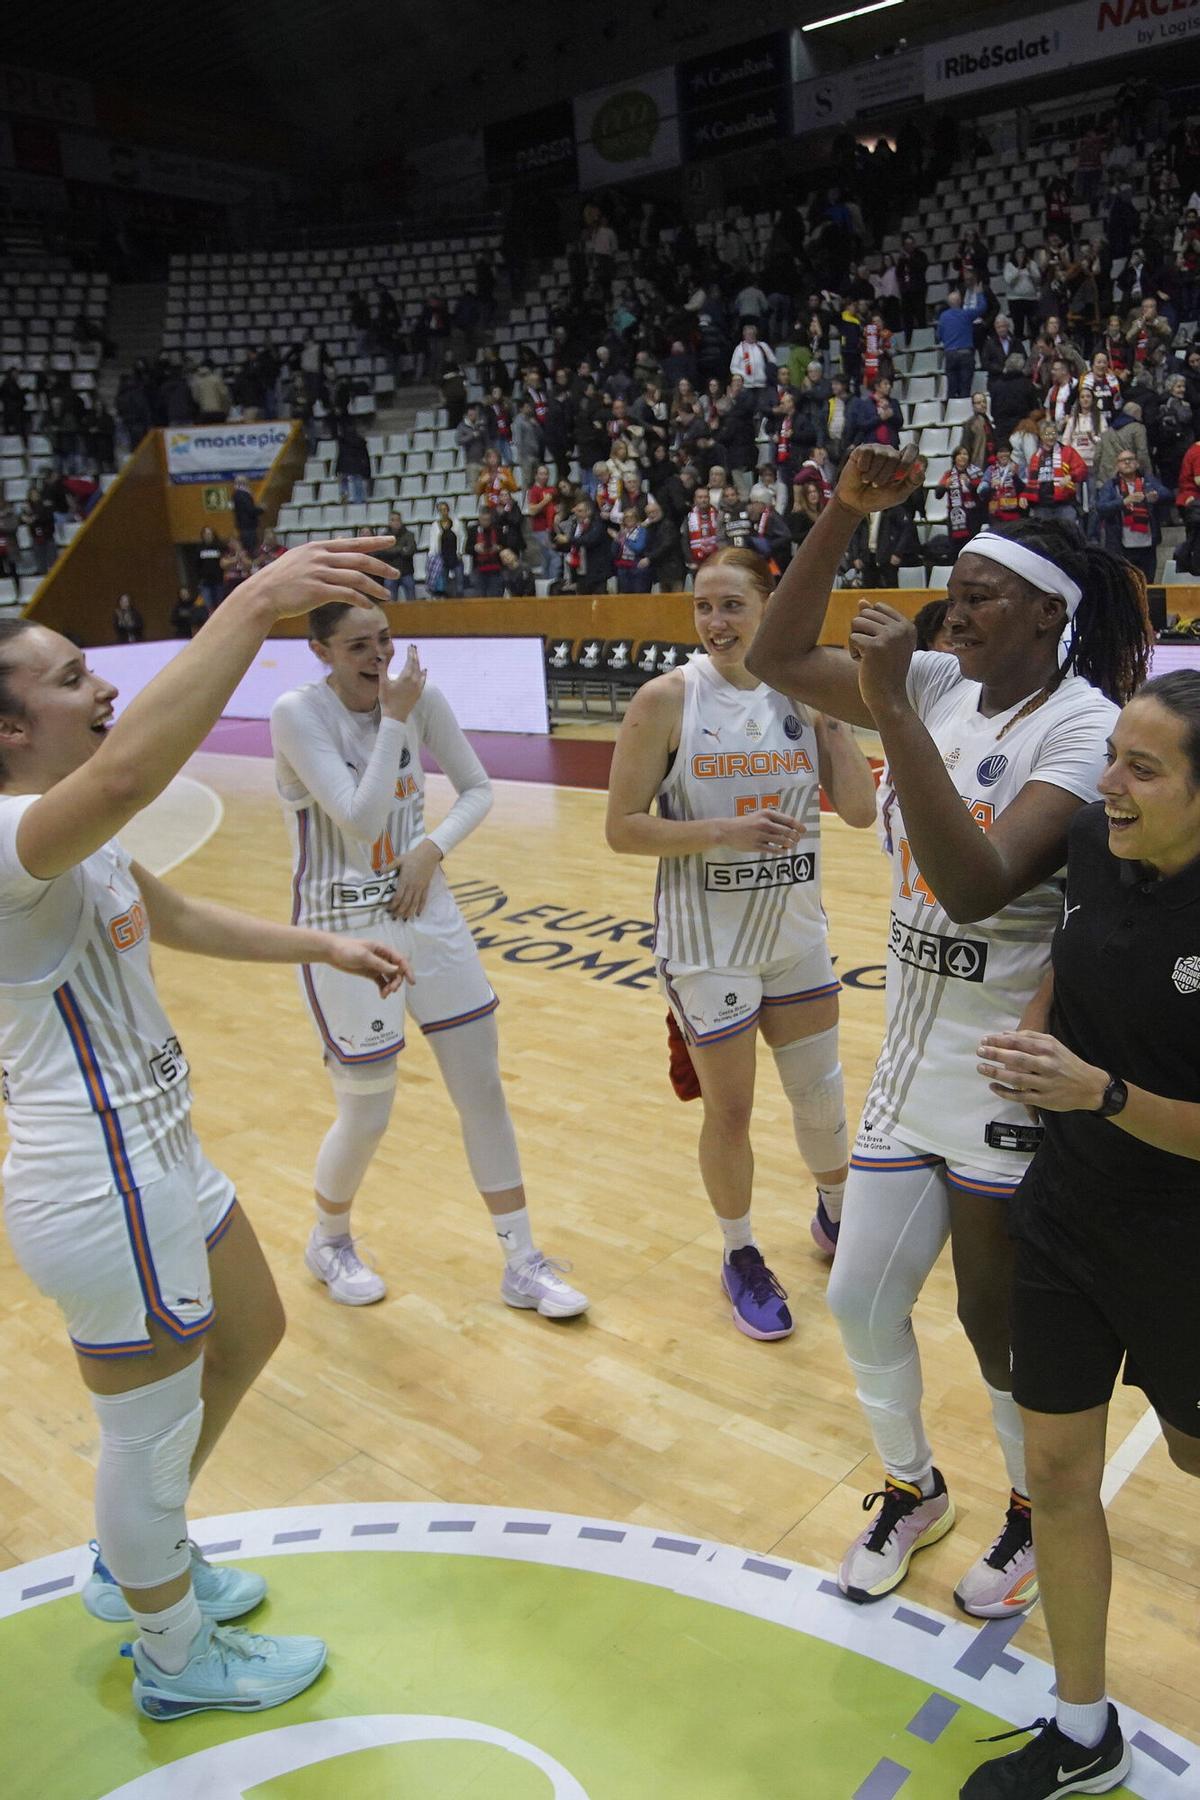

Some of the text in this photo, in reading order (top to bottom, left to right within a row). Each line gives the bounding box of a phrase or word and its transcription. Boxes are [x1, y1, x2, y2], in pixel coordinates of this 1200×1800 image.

[1137, 30, 1154, 43] by
[945, 36, 1049, 79] RibéSalat
[194, 428, 287, 448] montepio
[691, 749, 814, 780] GIRONA
[713, 864, 792, 885] SPAR
[340, 884, 397, 903] SPA
